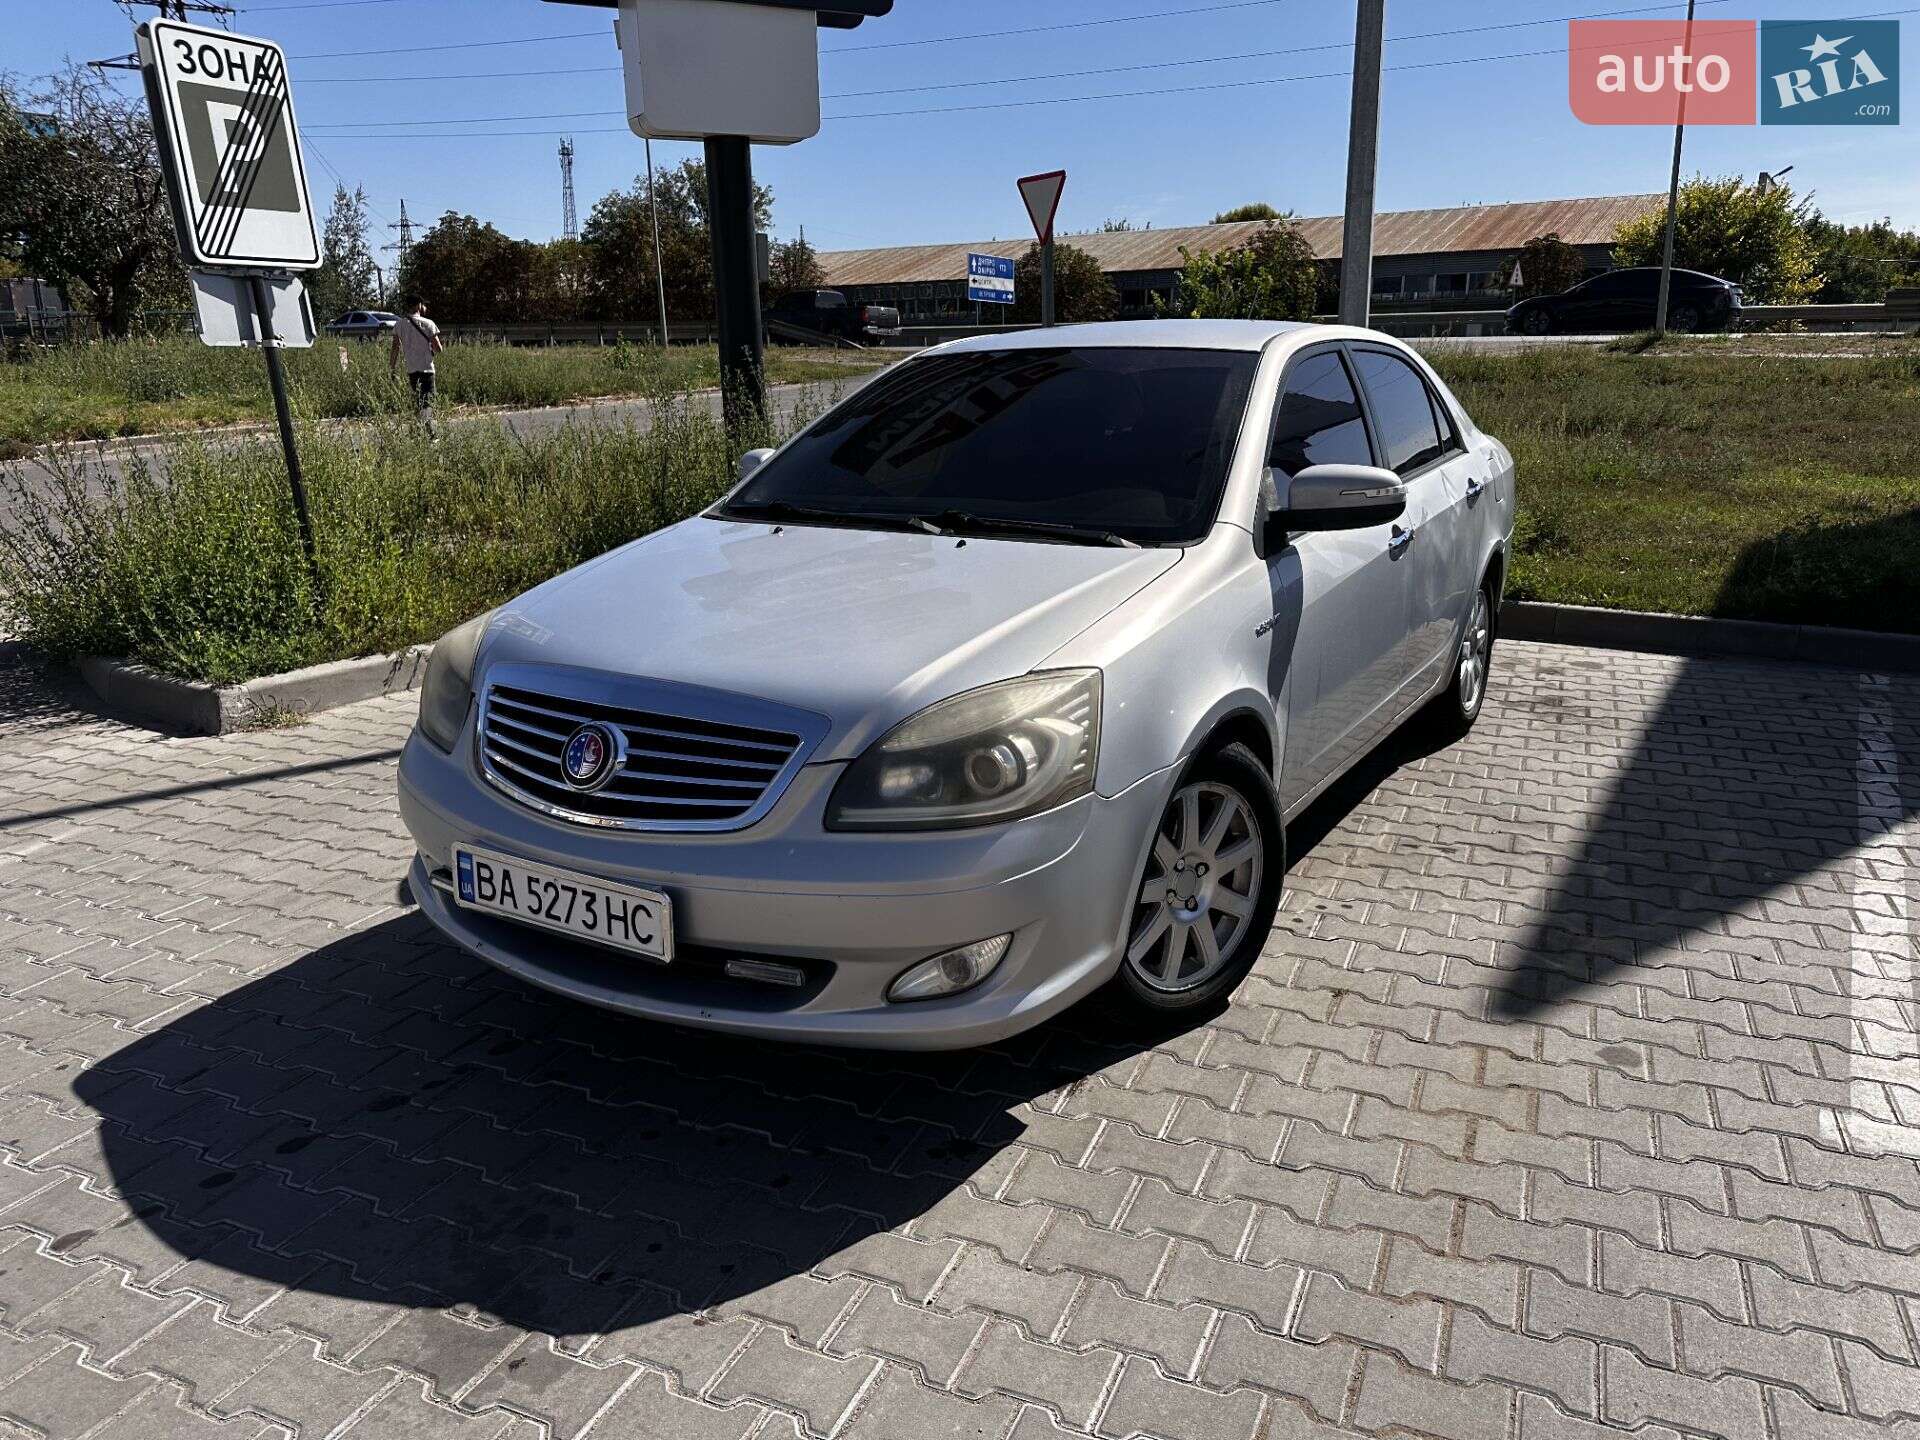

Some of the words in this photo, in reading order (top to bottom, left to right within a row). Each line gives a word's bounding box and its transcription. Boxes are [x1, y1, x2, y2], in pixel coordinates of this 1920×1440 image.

[172, 39, 276, 89] ЗОНА
[460, 881, 474, 896] UA
[475, 861, 519, 910] BA
[527, 875, 598, 931] 5273
[605, 895, 654, 945] HC
